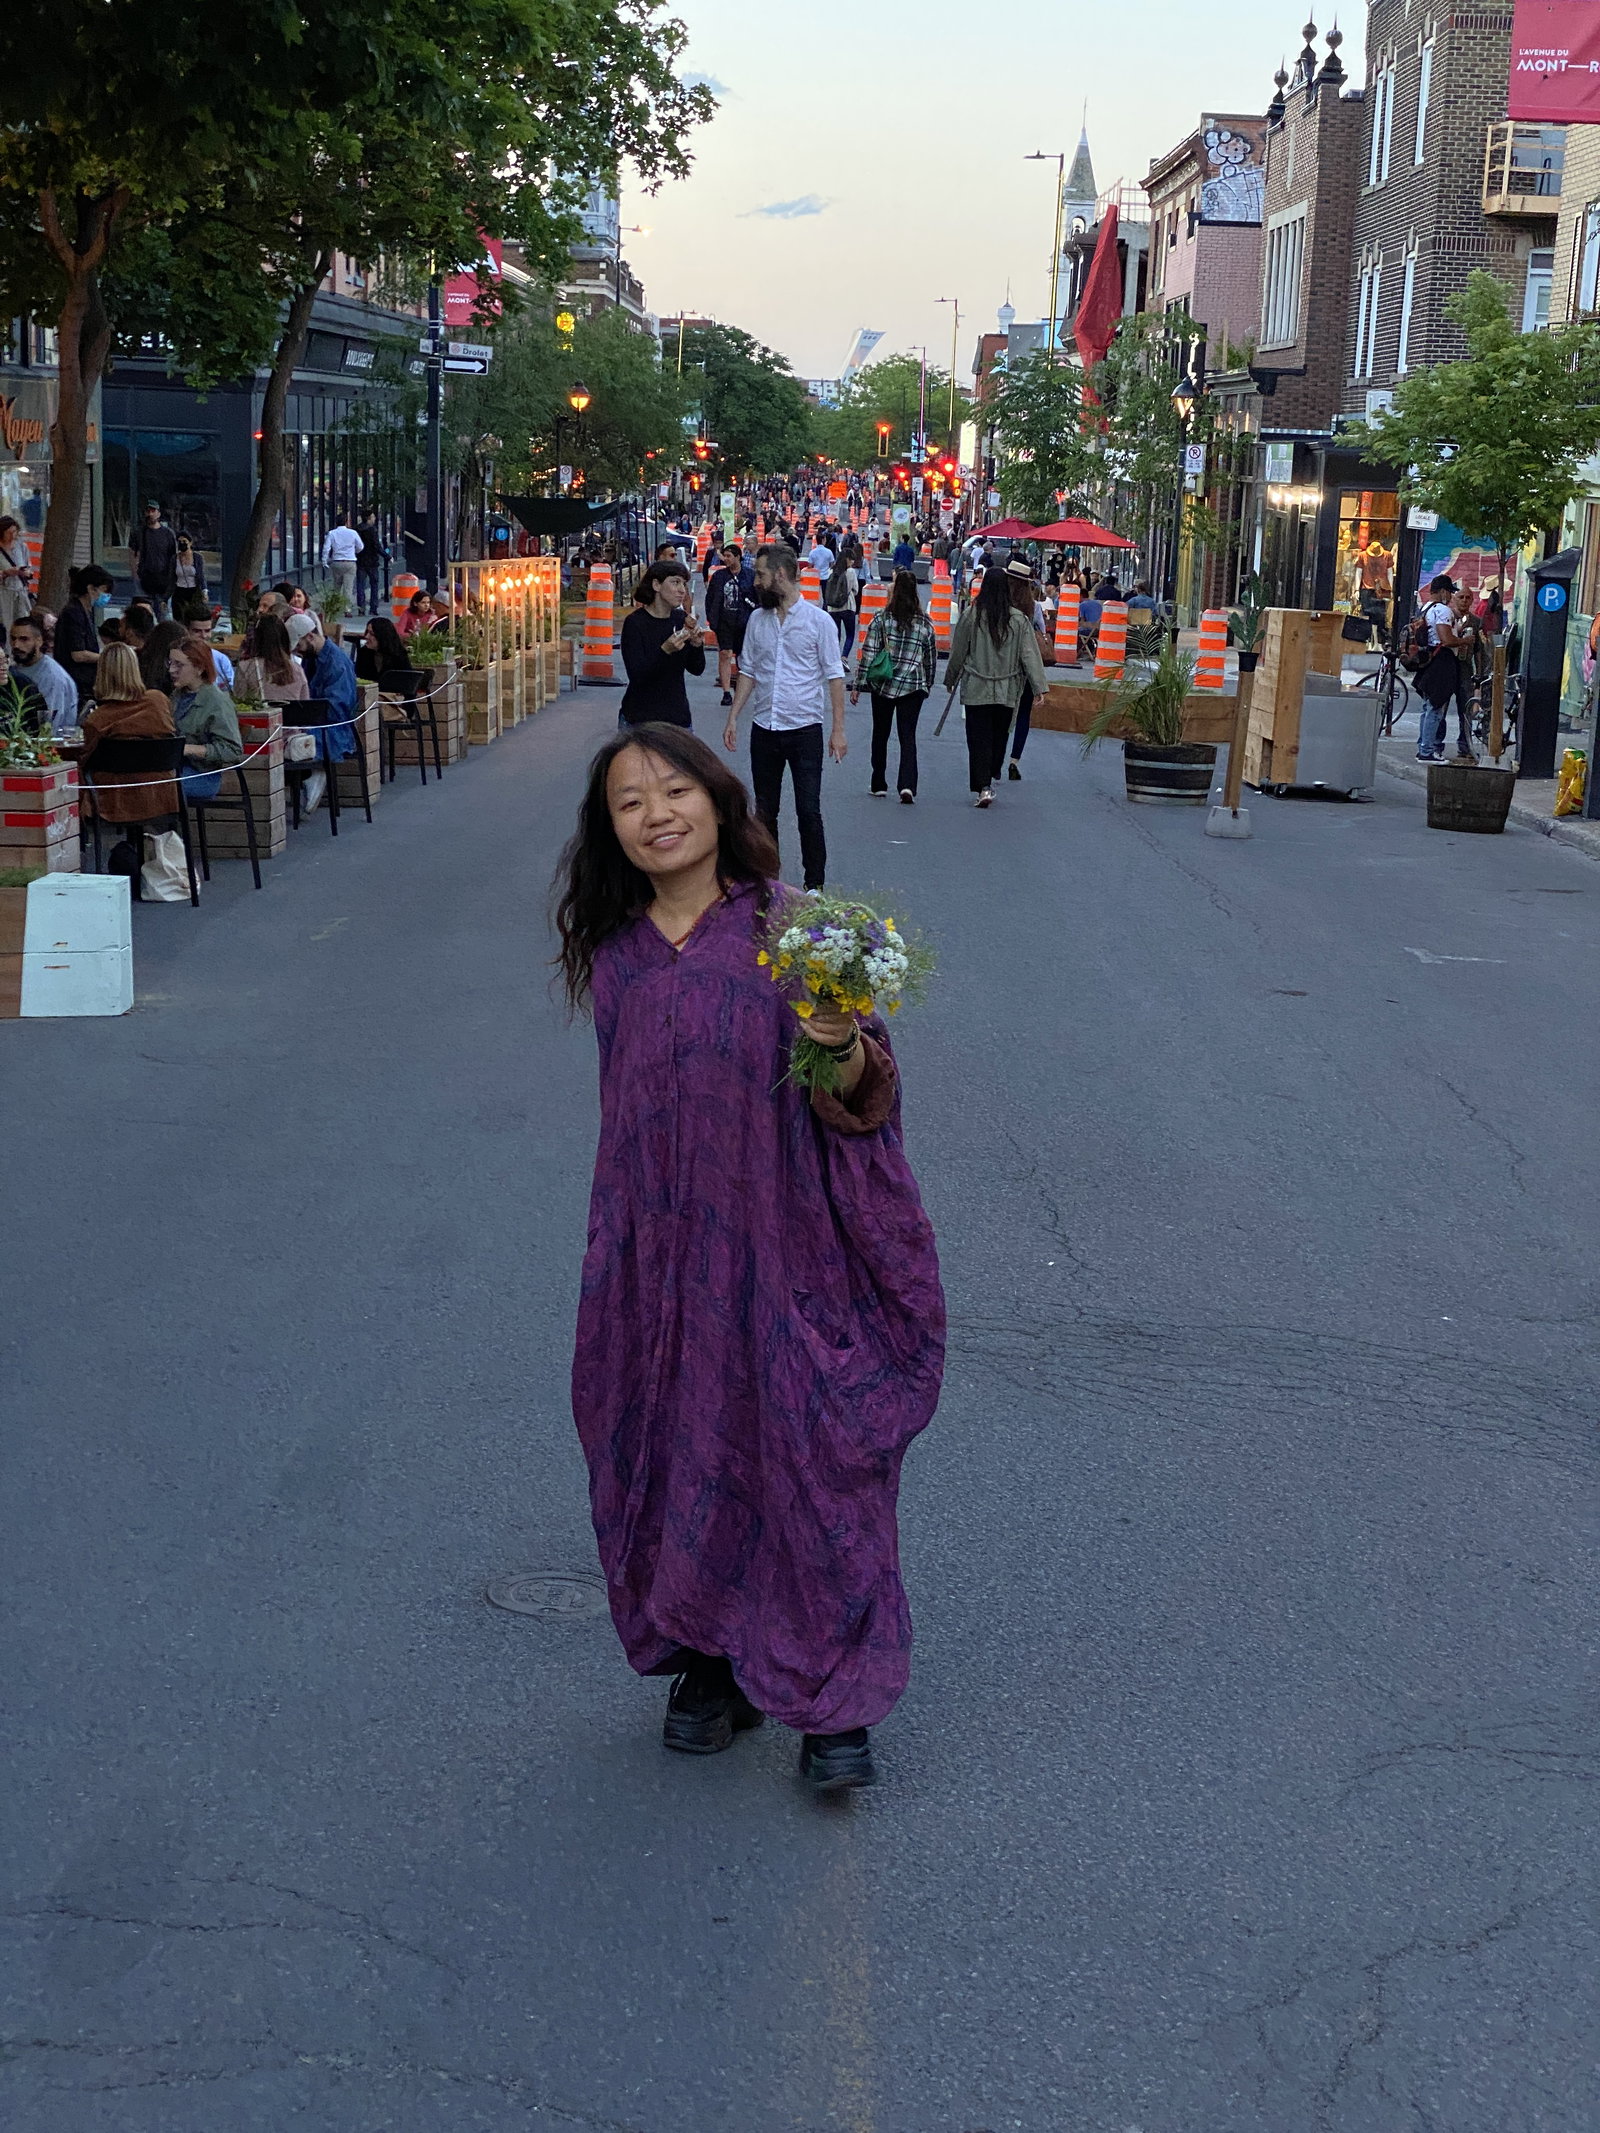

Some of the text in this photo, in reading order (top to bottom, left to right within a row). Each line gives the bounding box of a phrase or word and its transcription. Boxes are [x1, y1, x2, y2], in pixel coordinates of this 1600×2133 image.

[1519, 48, 1569, 57] L'AVENUE DU
[462, 347, 488, 358] Drolet
